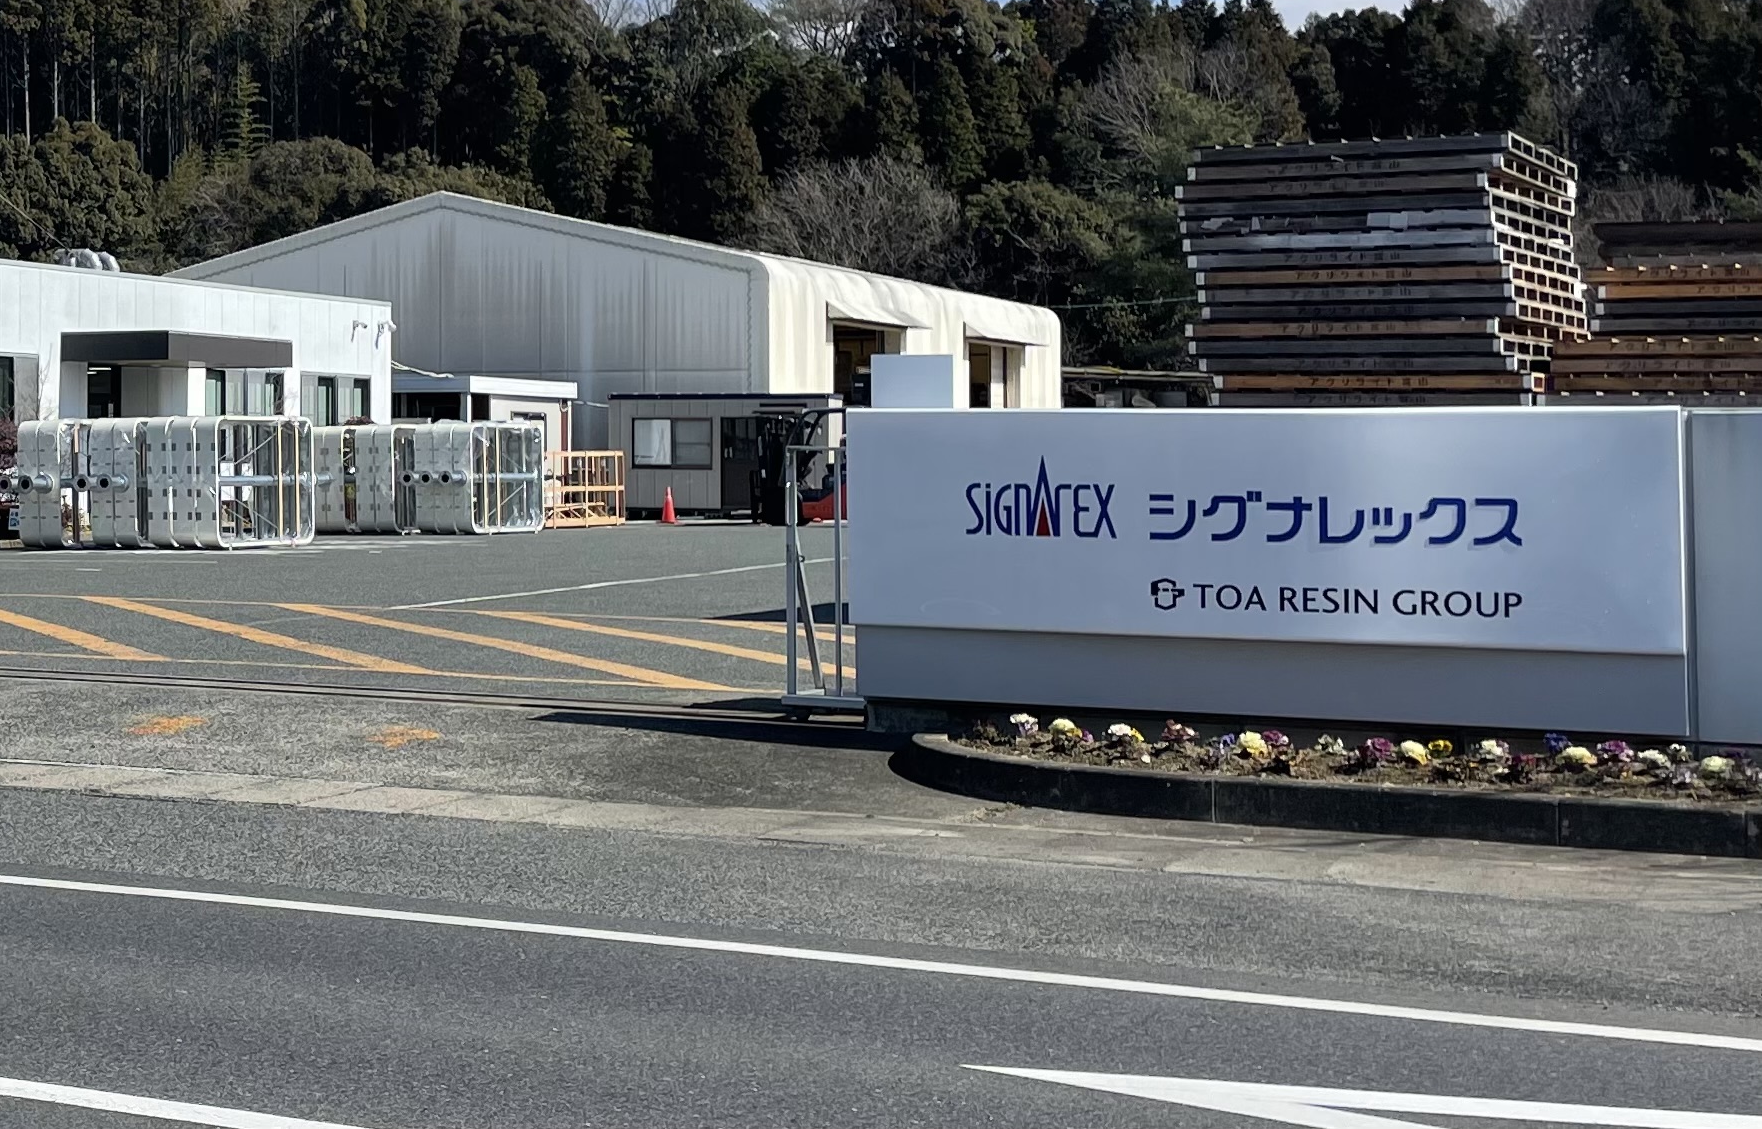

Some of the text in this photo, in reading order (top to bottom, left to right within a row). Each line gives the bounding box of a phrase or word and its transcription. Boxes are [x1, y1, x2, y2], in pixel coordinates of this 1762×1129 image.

[1149, 490, 1523, 547] シグナレックス
[1193, 583, 1522, 618] TOA RESIN GROUP
